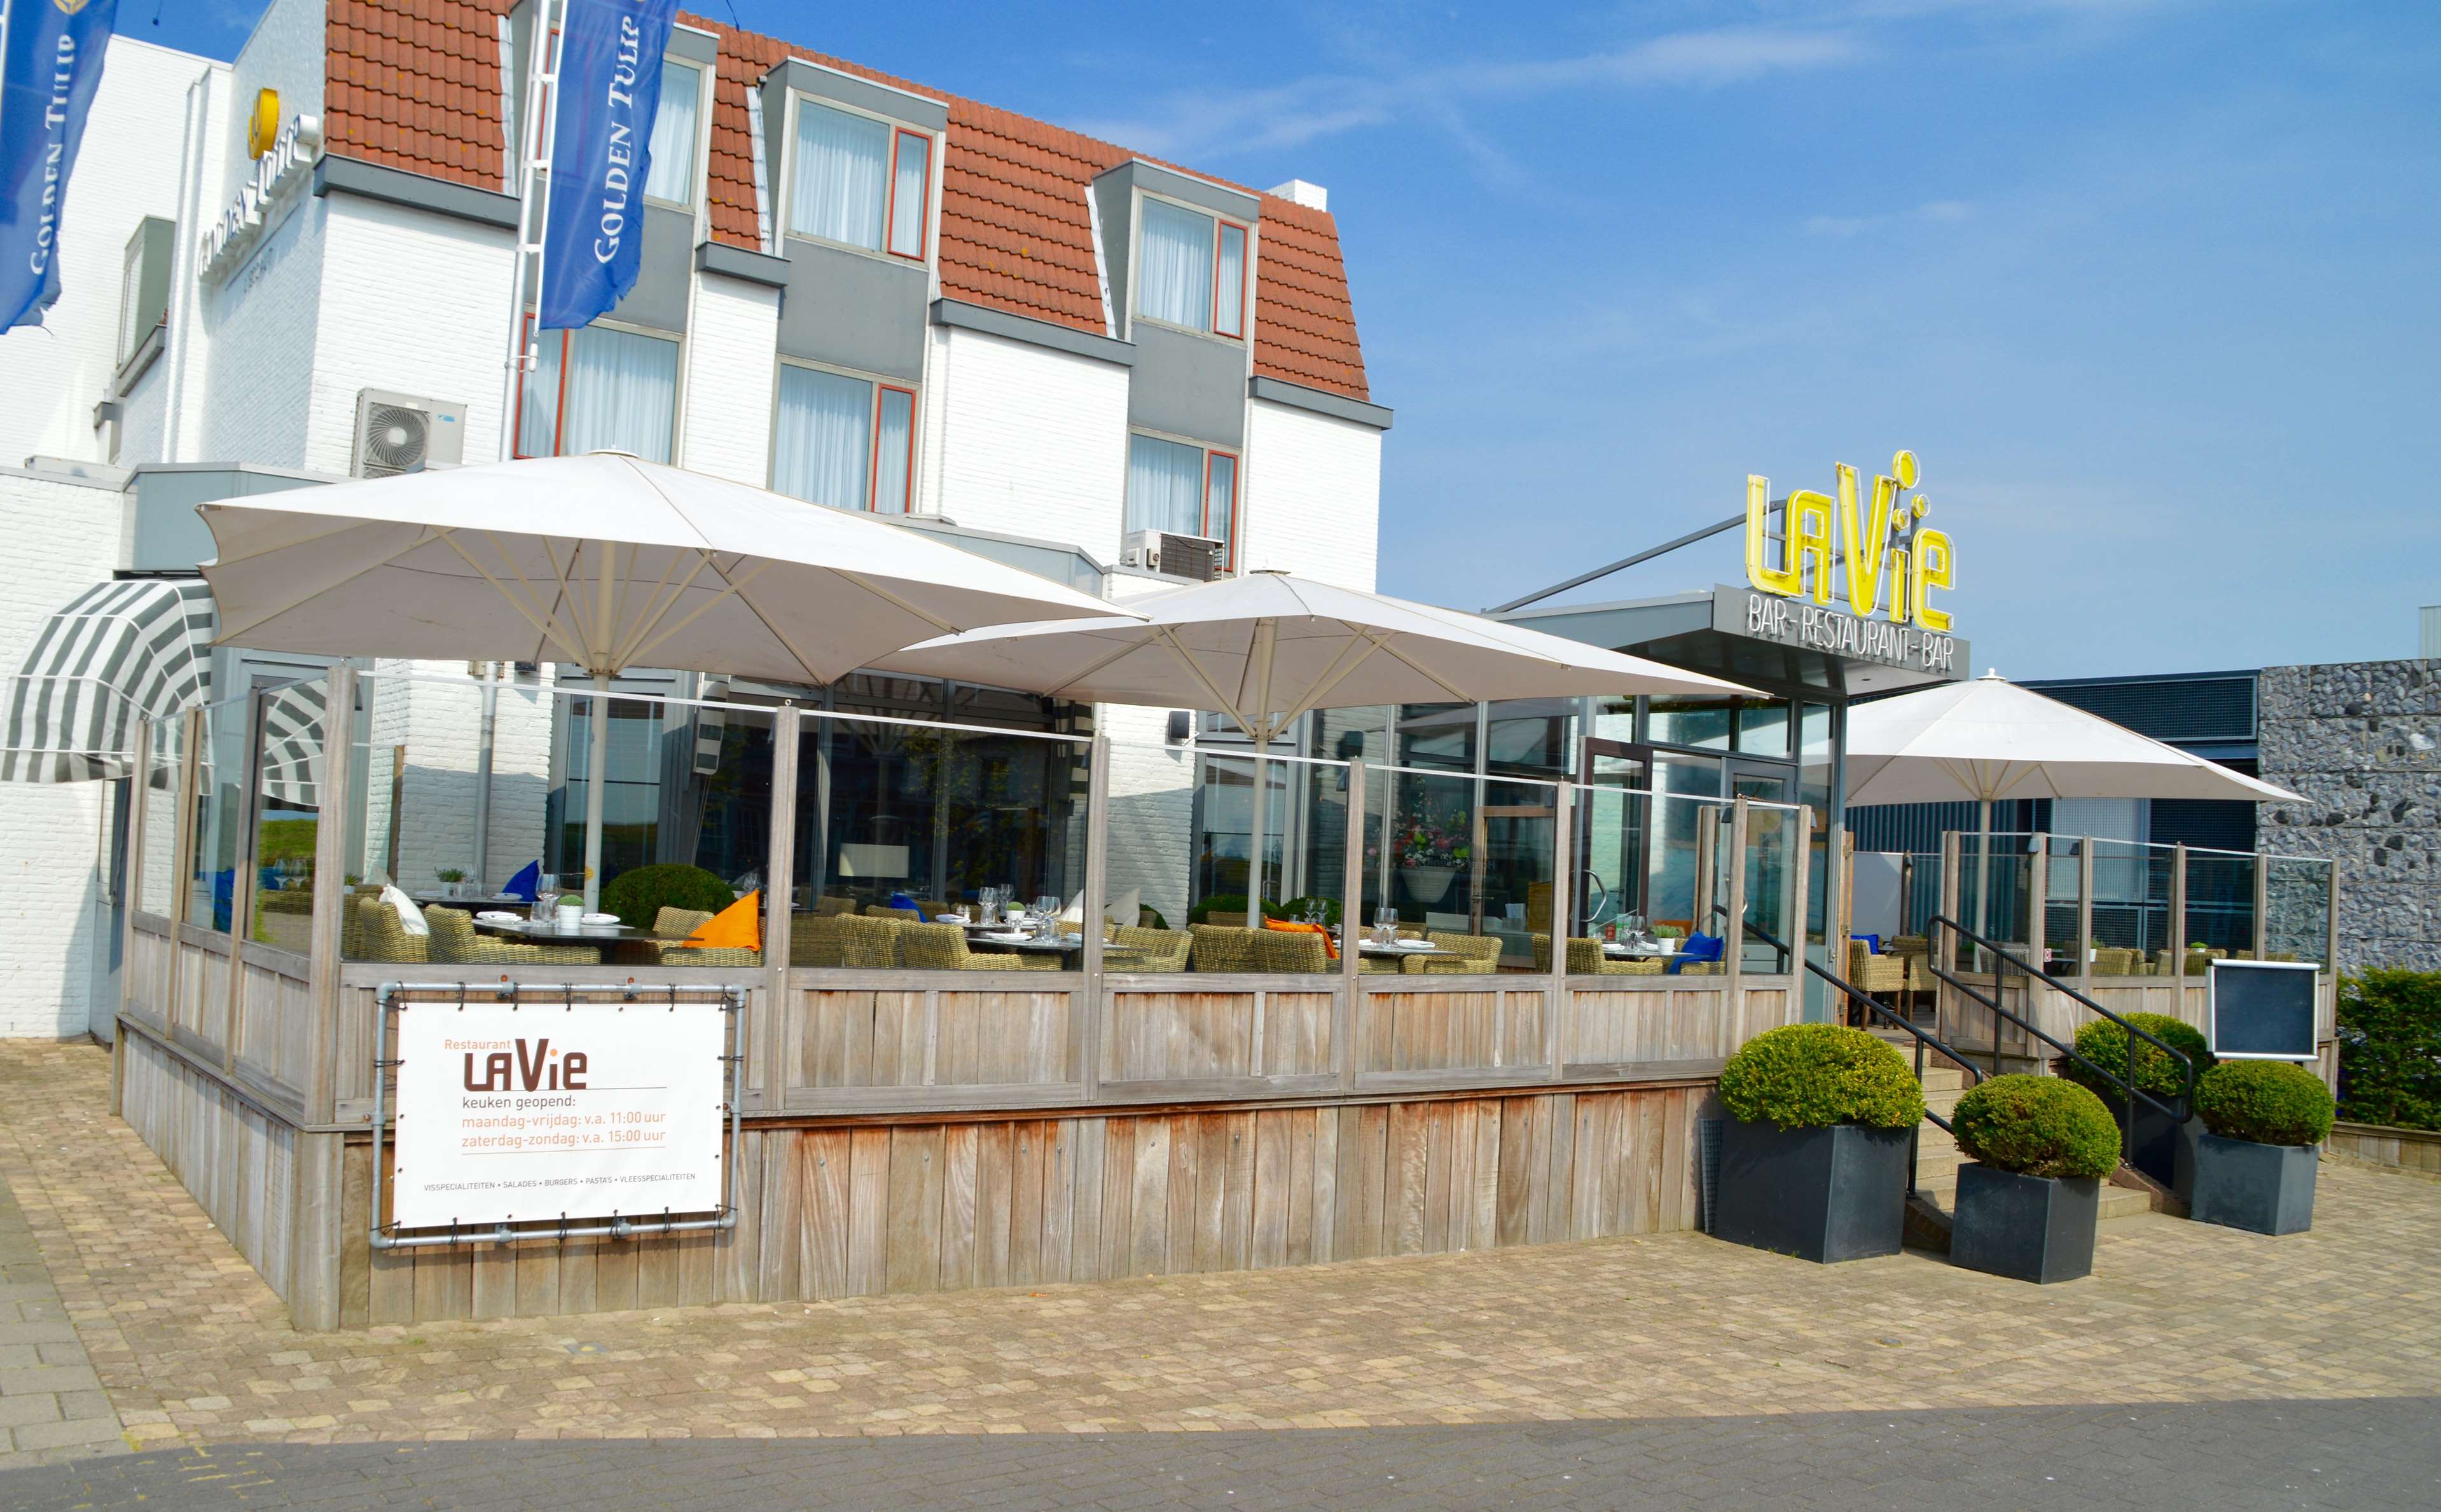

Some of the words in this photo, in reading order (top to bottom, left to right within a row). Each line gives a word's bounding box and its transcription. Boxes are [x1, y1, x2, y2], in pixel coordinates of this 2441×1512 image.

[608, 15, 640, 109] TULIP
[594, 121, 632, 264] GOLDEN
[1749, 594, 1787, 638] BAR
[1801, 605, 1911, 662] RESTAURANT
[1921, 632, 1954, 671] BAR
[445, 1039, 511, 1050] Restaurant
[462, 1096, 511, 1109] keuken
[516, 1094, 576, 1111] geopend:
[462, 1113, 581, 1130] maandag-vrijdag:
[584, 1114, 606, 1124] v.a.
[610, 1111, 642, 1124] 11:00
[644, 1112, 667, 1123] uur
[462, 1132, 579, 1148] zaterdag-zondag:
[583, 1132, 604, 1143] v.a.
[608, 1130, 641, 1142] 15:00
[644, 1131, 666, 1141] uur
[424, 1182, 495, 1191] VISSPECIALITEITEN
[503, 1179, 537, 1188] SALADES
[544, 1178, 577, 1186] BURGERS
[585, 1176, 612, 1185] PASTA'S
[619, 1173, 696, 1183] VLEESSPECIALITEITEN
